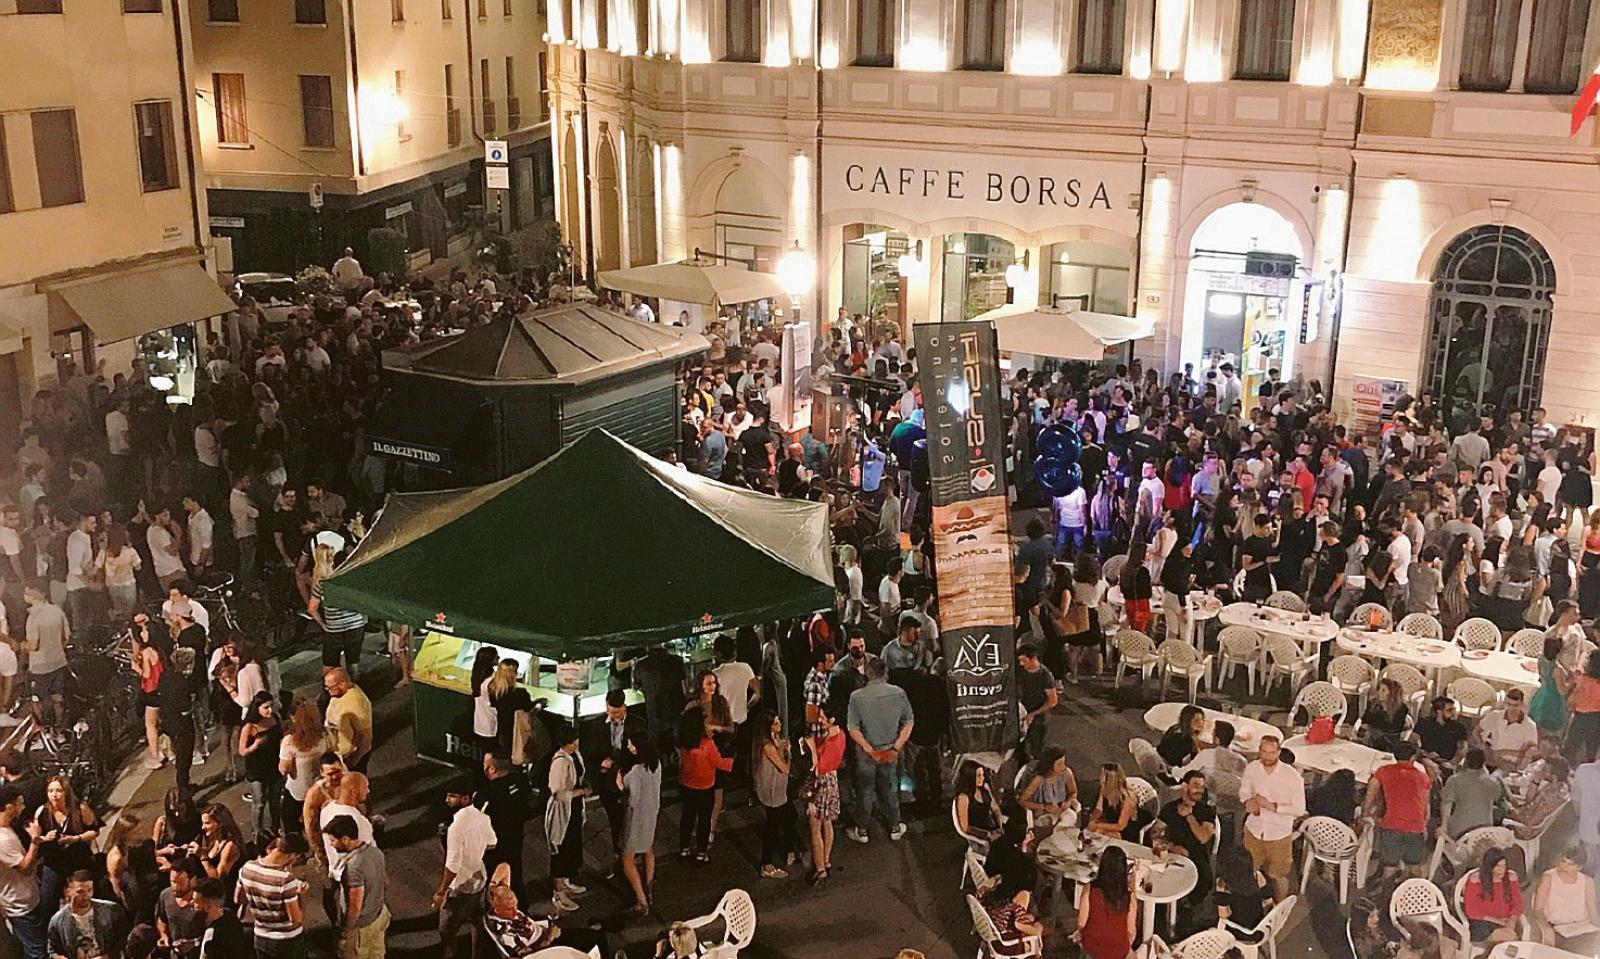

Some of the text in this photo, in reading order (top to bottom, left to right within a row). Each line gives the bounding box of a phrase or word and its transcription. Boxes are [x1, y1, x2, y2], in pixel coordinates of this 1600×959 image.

[845, 164, 1112, 210] CAFFE BORSA
[383, 444, 441, 463] GAZZETTINO
